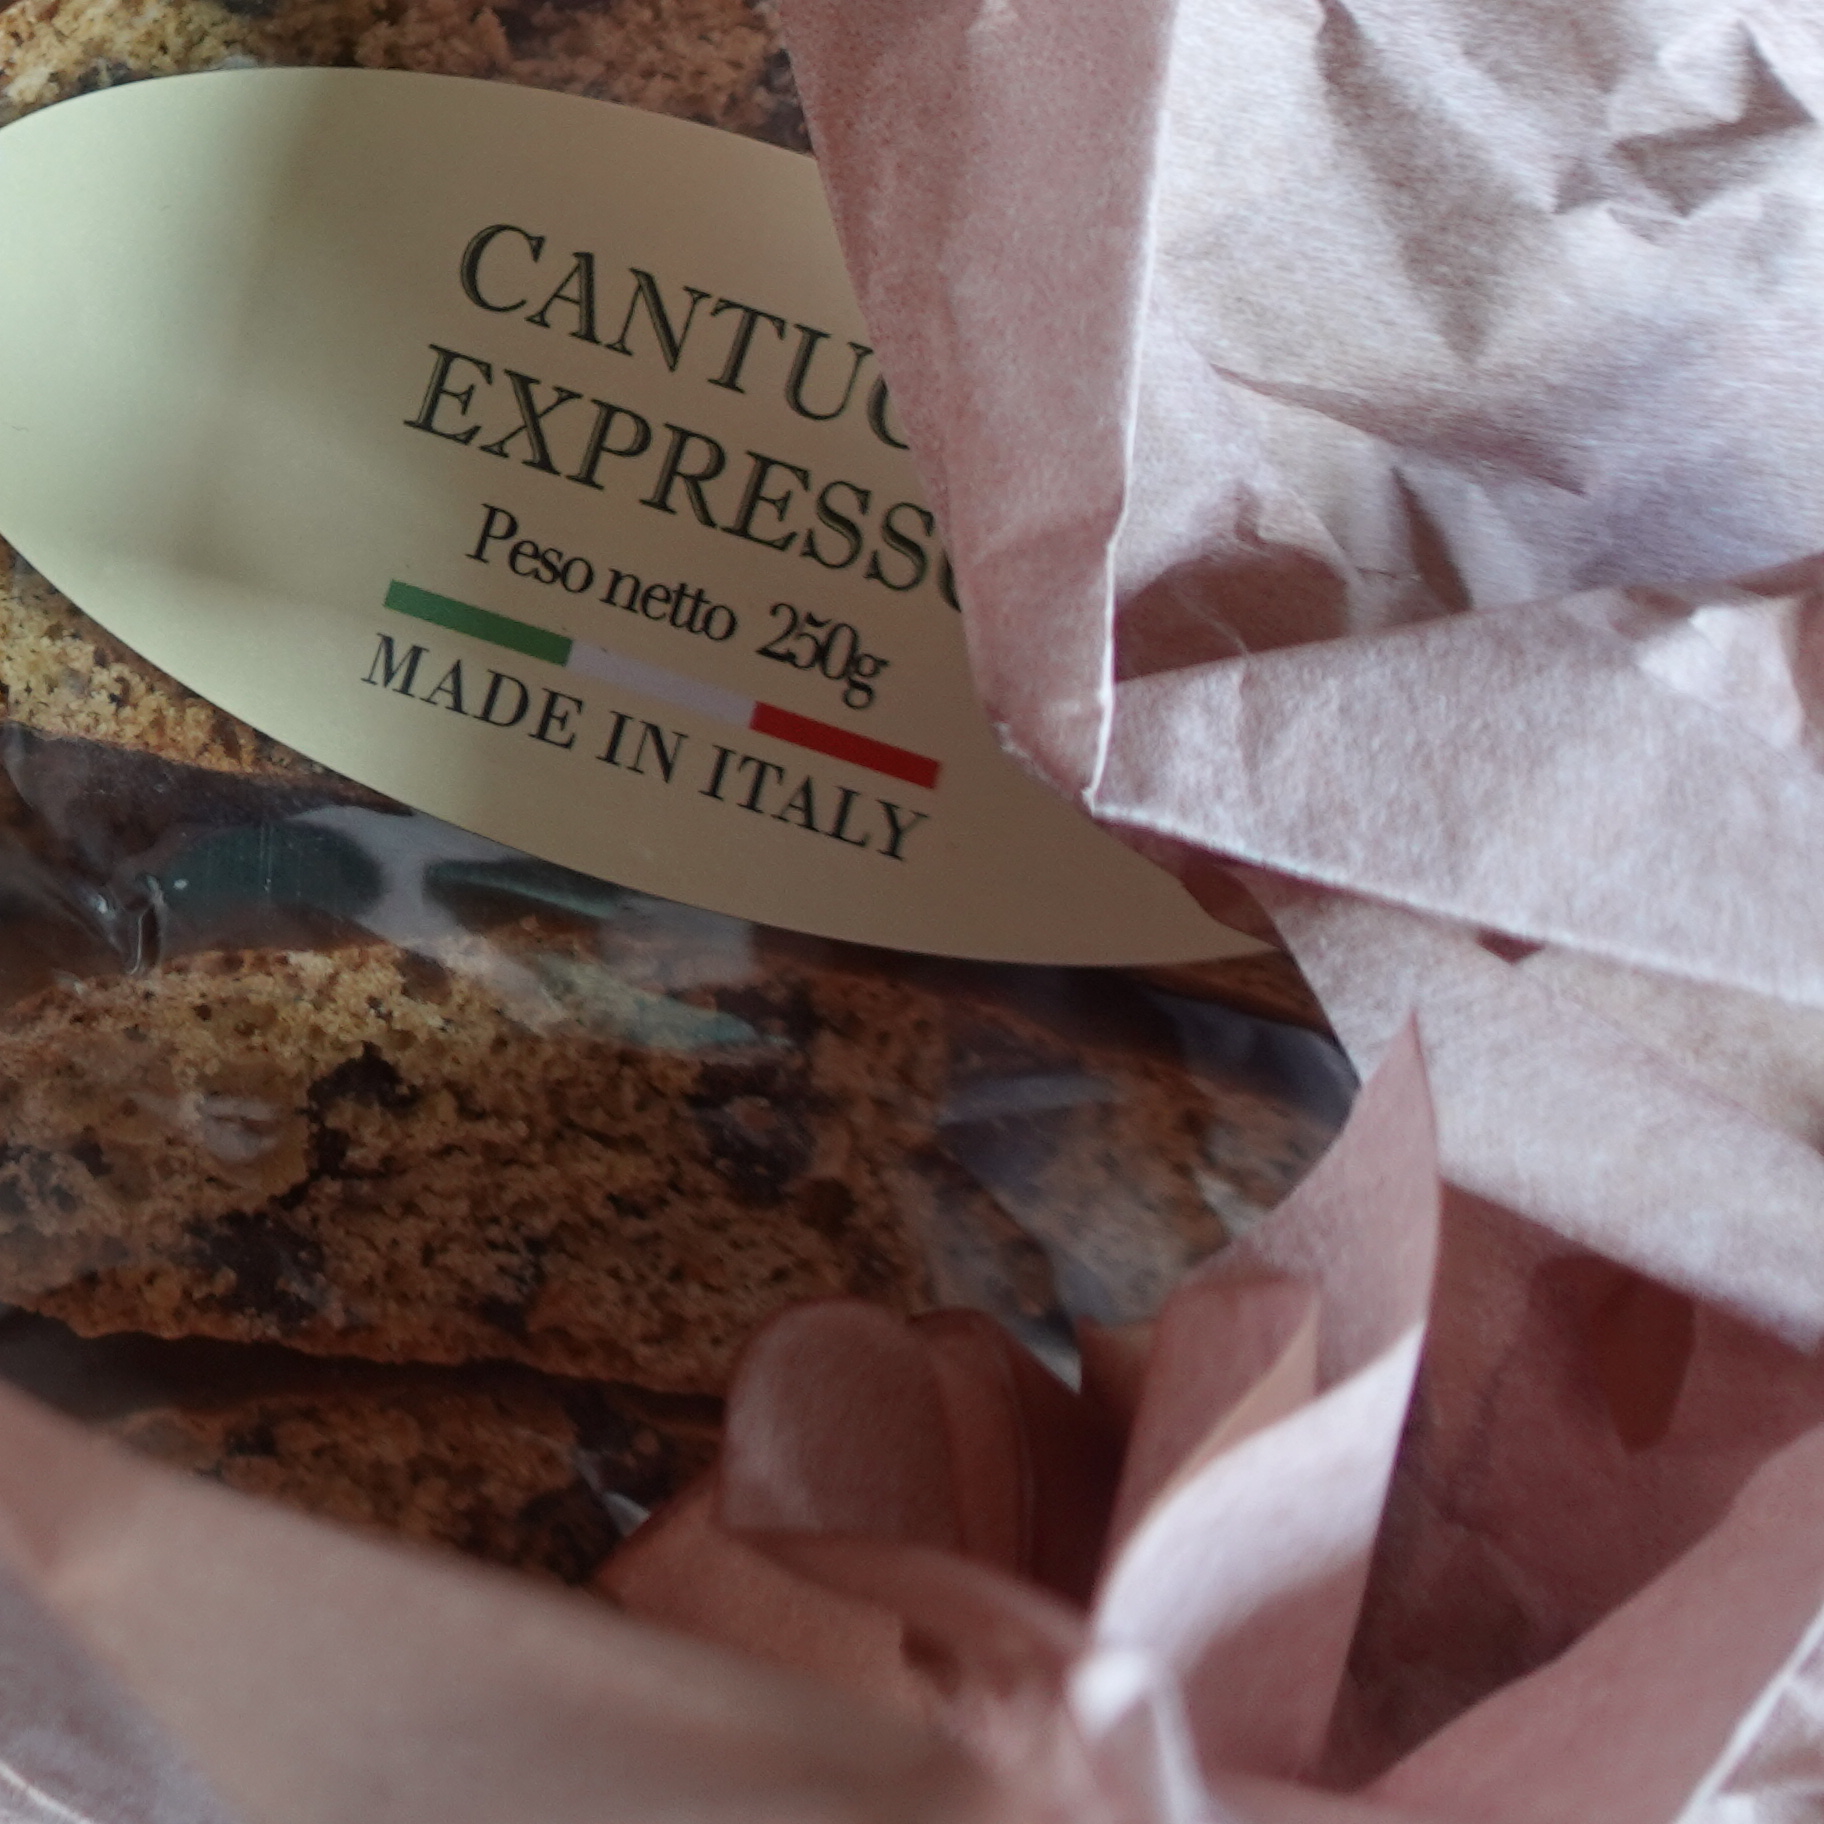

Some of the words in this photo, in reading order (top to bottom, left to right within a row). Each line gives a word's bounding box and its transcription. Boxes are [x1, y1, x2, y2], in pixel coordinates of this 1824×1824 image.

[403, 343, 964, 613] EXPRESS
[466, 503, 595, 595] Peso
[603, 566, 739, 643] netto
[756, 602, 890, 710] 250g
[361, 632, 584, 751] MADE
[596, 710, 689, 784] IN
[699, 744, 930, 862] ITALY
